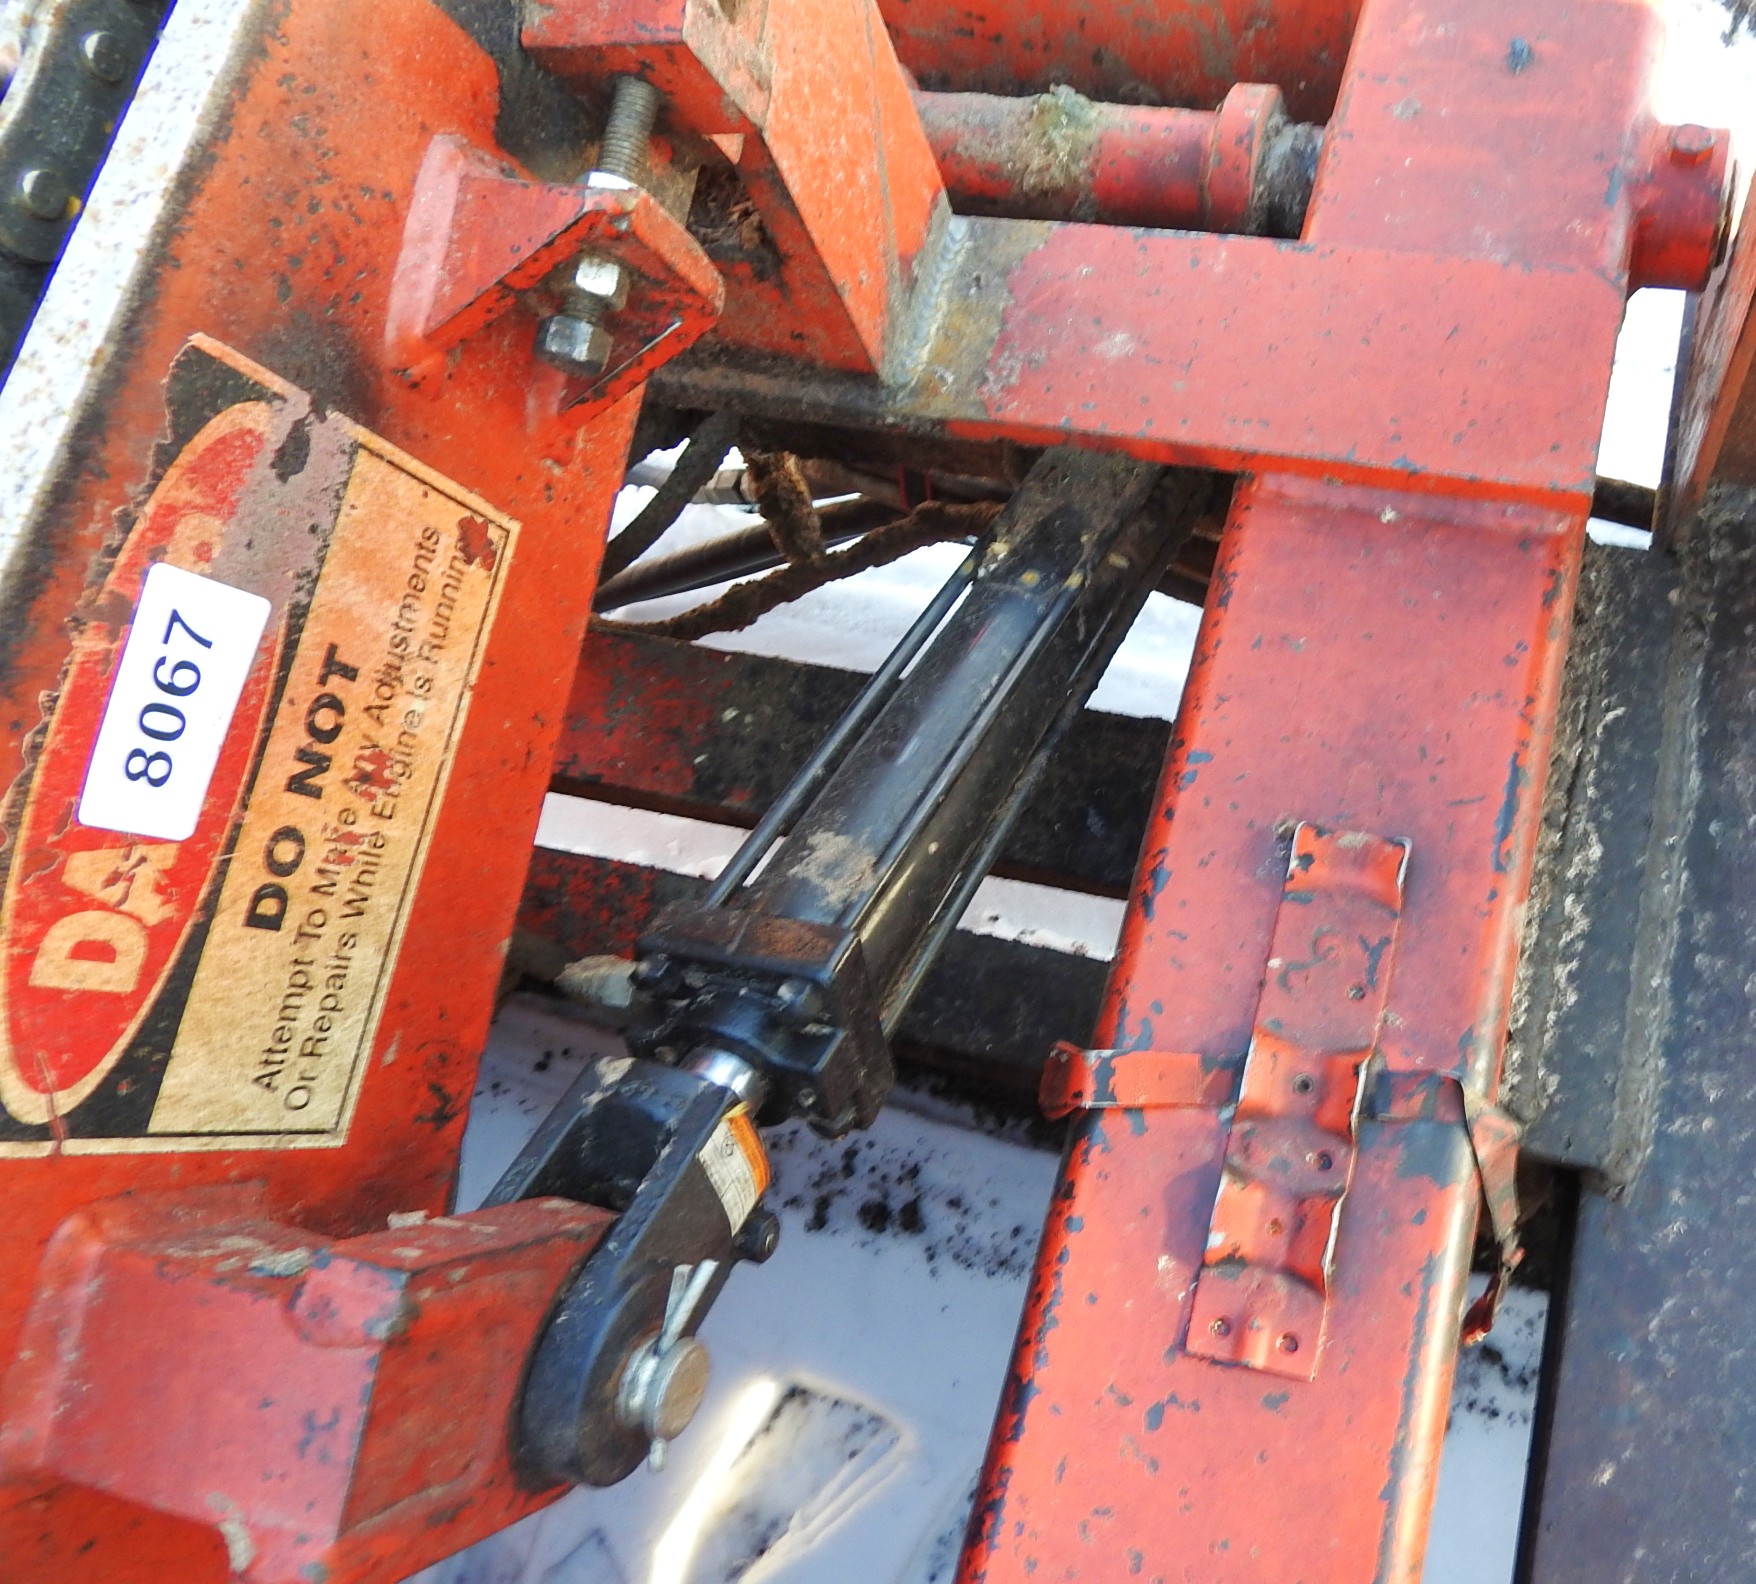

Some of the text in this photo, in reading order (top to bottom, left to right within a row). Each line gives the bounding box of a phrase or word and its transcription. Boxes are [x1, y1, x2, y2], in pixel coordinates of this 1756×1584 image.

[125, 608, 213, 788] 8067
[405, 675, 434, 701] Is
[243, 643, 360, 932] DO NOT
[251, 957, 315, 1093] Attempt
[291, 908, 328, 947] To
[362, 526, 440, 728] Adjustments
[370, 709, 422, 820] Engine
[339, 831, 386, 918] While
[299, 932, 358, 1058] Repairs
[284, 1074, 319, 1111] Or
